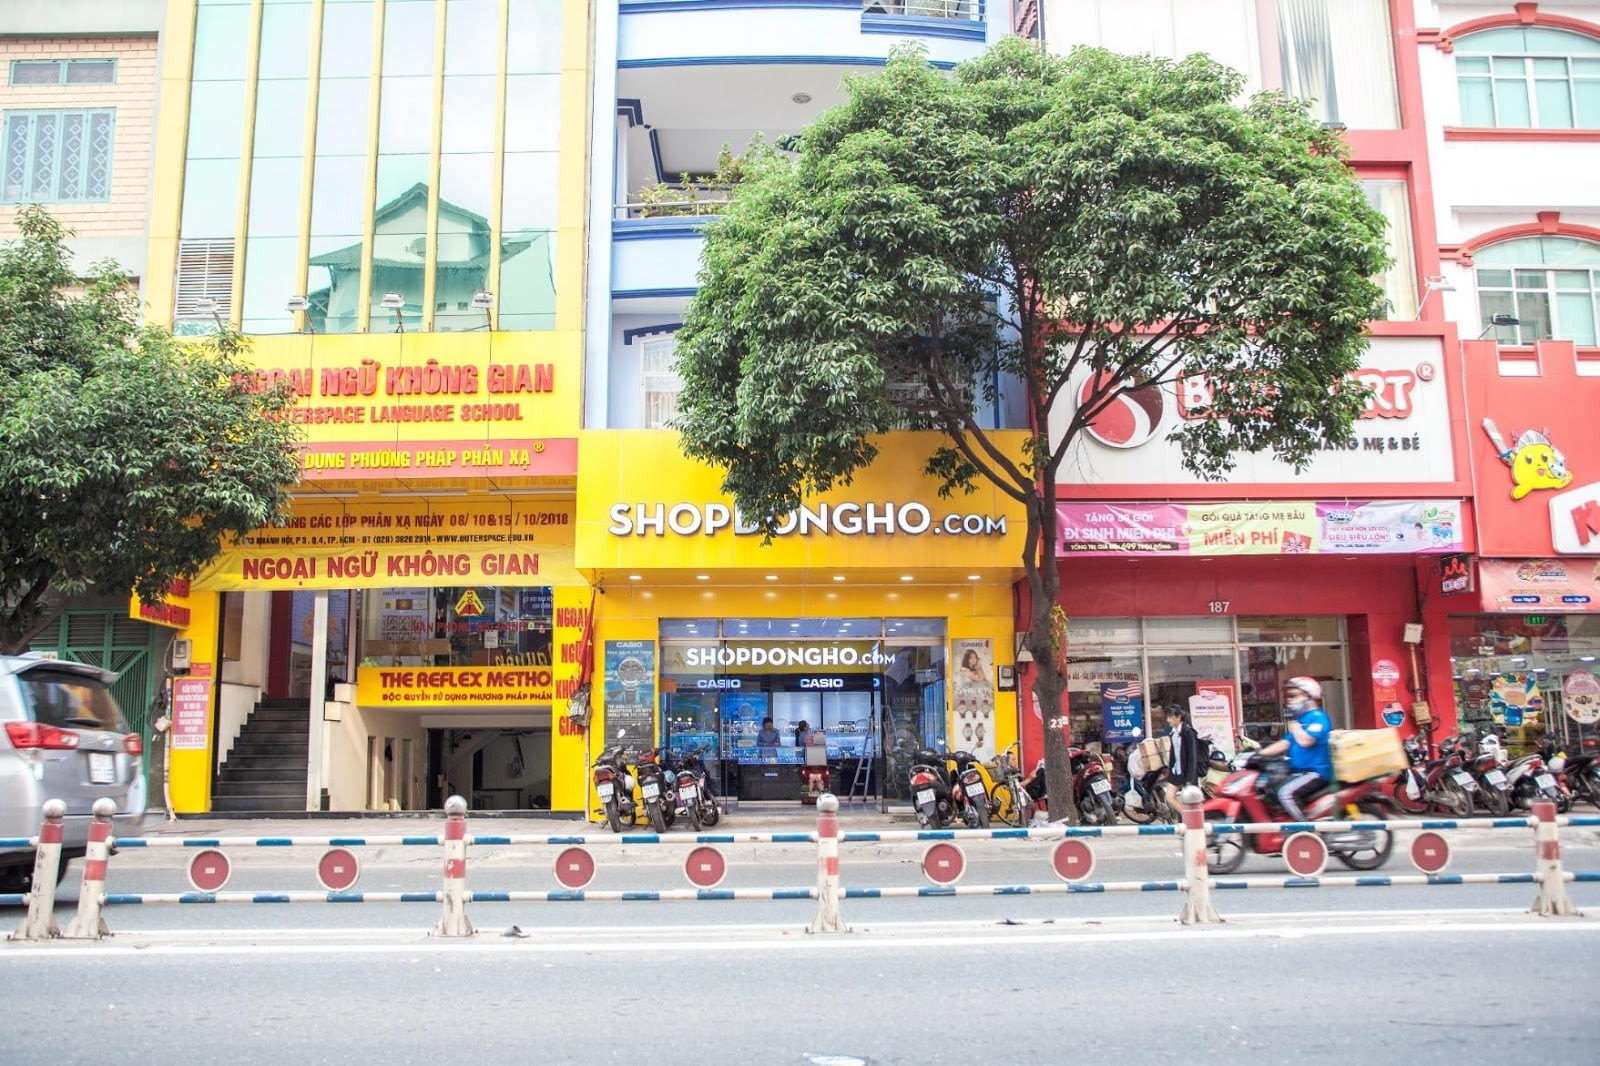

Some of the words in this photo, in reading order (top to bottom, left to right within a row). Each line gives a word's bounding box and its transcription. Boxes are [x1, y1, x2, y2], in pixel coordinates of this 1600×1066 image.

[321, 359, 381, 396] NGỮ
[386, 359, 478, 395] KHÔNG
[487, 364, 554, 393] GIAN
[370, 405, 455, 423] LANGUAGE
[461, 403, 523, 421] SCHOOL
[1363, 438, 1384, 454] MẸ
[1388, 437, 1399, 450] &
[1402, 432, 1420, 450] BÉ
[305, 452, 346, 475] DỤNG
[350, 448, 411, 469] PHƯƠNG
[416, 447, 457, 467] PHÁP
[461, 443, 504, 467] PHẢN
[509, 449, 531, 471] XẠ
[310, 513, 332, 529] CÁC
[361, 511, 392, 528] PHẢN
[395, 515, 411, 529] XẠ
[415, 512, 444, 528] NGÀY
[1202, 512, 1220, 522] GÓI
[1081, 528, 1114, 540] SINH
[1251, 527, 1279, 545] PHÍ
[243, 556, 316, 586] NGOẠI
[327, 551, 379, 578] NGỮ
[387, 550, 471, 577] KHÔNG
[481, 553, 539, 576] GIAN
[1208, 601, 1230, 613] 187
[380, 672, 413, 688] THE
[417, 671, 482, 688] REFLEX
[486, 671, 552, 688] METHO
[697, 679, 741, 689] CASIO
[800, 678, 844, 688] CASIO
[382, 691, 401, 703] ĐỘC
[445, 694, 468, 703] DỤNG
[506, 691, 528, 701] PHÁP
[1113, 719, 1132, 727] USA
